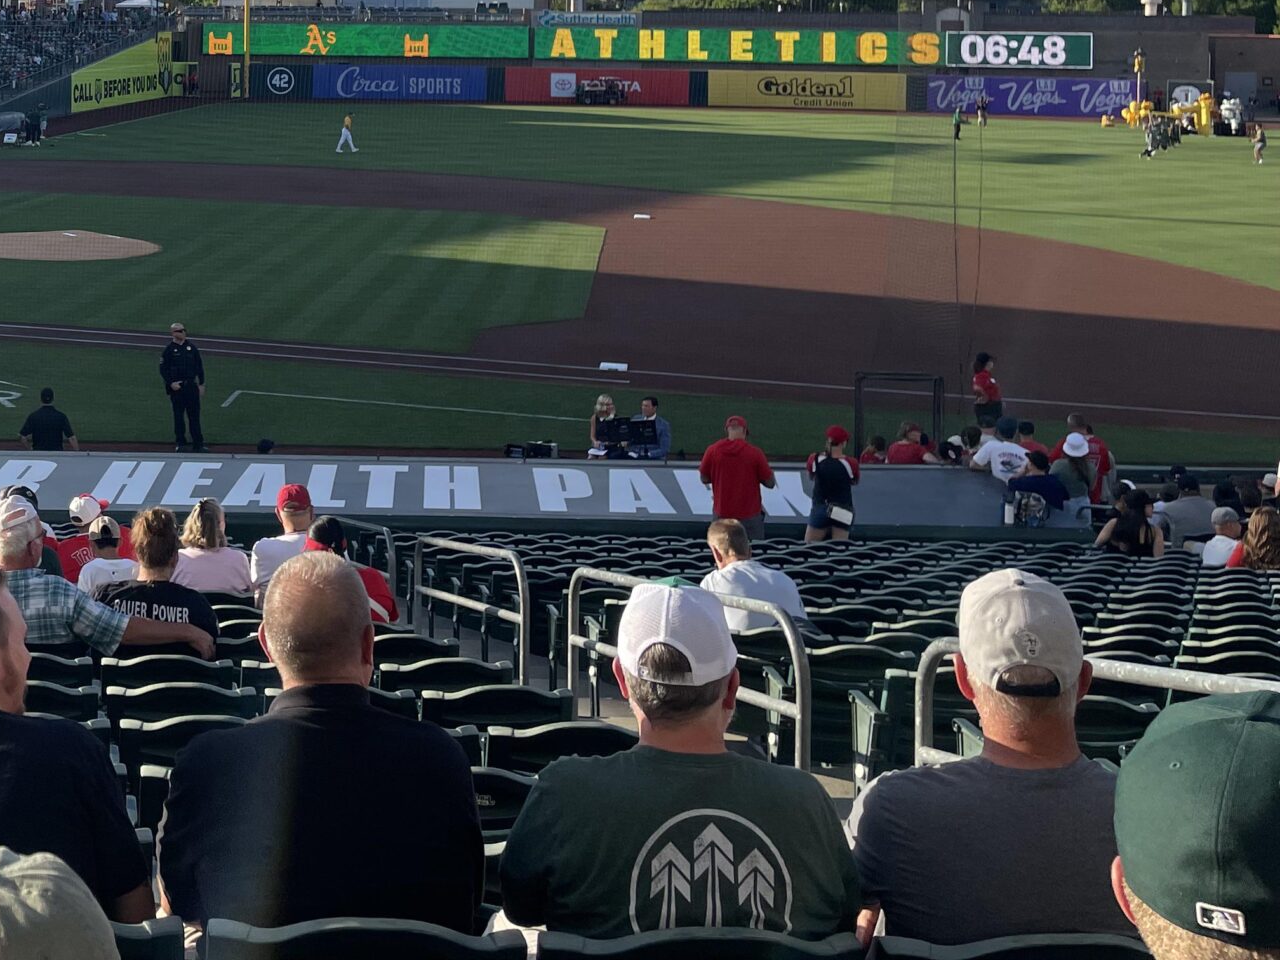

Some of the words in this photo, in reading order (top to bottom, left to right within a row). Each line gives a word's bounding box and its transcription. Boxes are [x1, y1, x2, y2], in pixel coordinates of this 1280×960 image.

[300, 24, 337, 55] A's
[960, 34, 1066, 65] 06:48
[73, 82, 93, 103] CALL
[103, 77, 131, 99] BEFORE
[132, 75, 146, 93] YOU
[146, 74, 158, 92] DIG
[271, 73, 289, 88] 42
[336, 66, 399, 98] Circa
[409, 77, 462, 94] SPORTS
[581, 80, 641, 92] TOTA
[929, 79, 995, 111] Vegas
[793, 97, 821, 107] Credit
[826, 98, 854, 107] Union
[999, 80, 1067, 113] Vegas
[1072, 82, 1132, 115] Vegas
[101, 460, 482, 510] HEALTH
[532, 467, 812, 518] PAK
[152, 604, 190, 623] POWER
